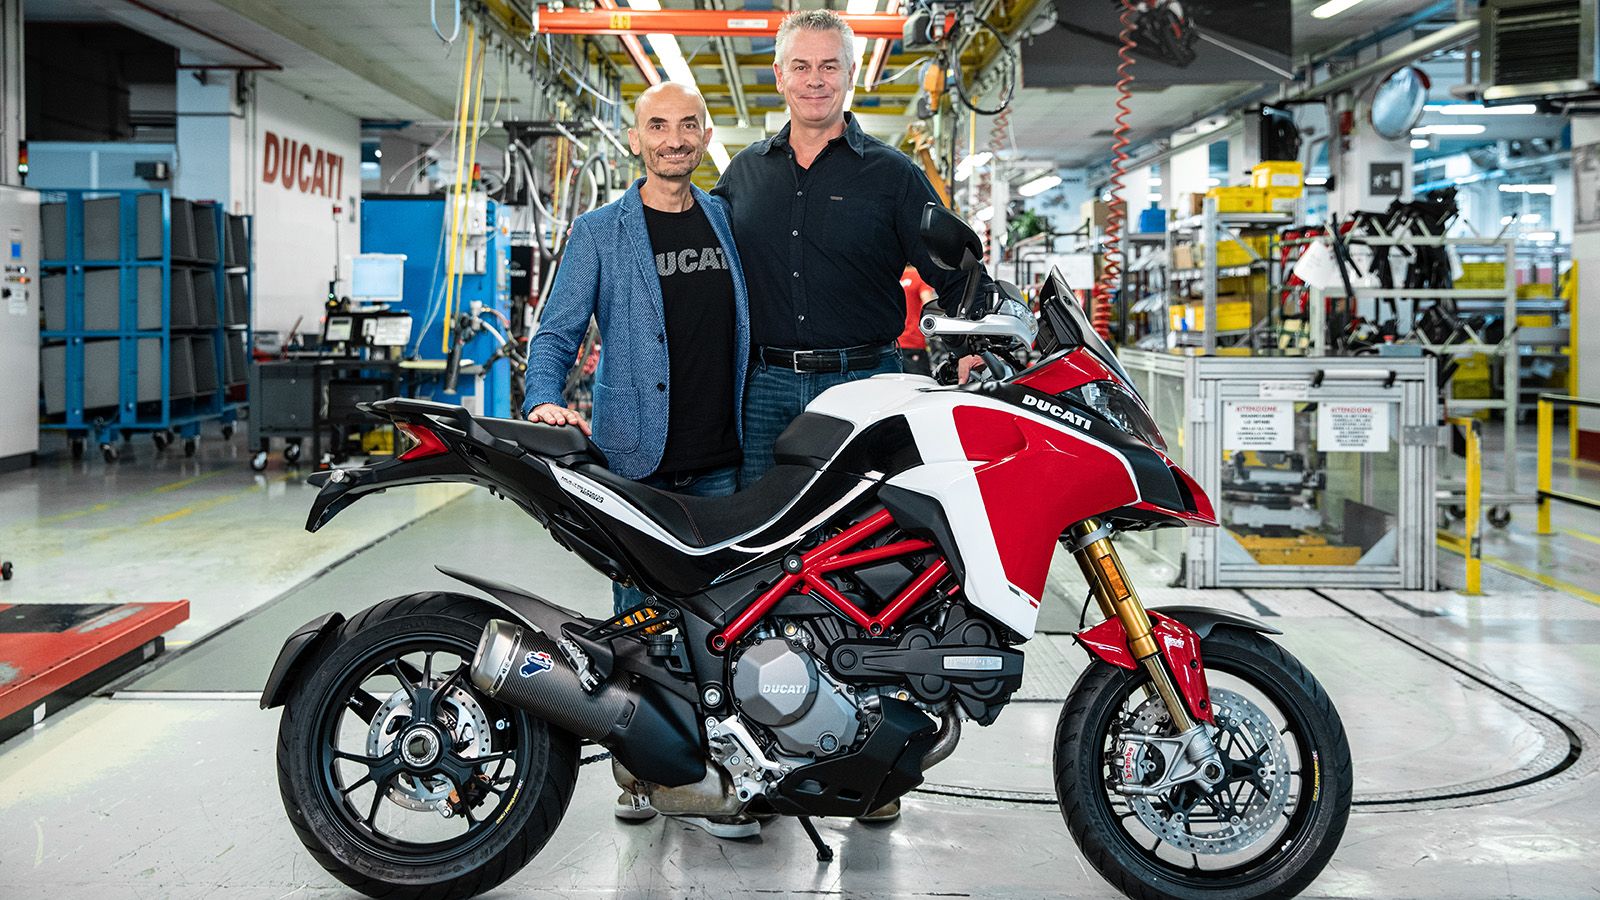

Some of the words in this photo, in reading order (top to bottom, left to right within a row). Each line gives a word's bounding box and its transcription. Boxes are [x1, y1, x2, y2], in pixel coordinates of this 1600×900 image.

[262, 130, 344, 201] DUCATI
[655, 246, 729, 277] UCAT
[1021, 393, 1092, 431] DUCATI
[762, 684, 807, 694] DUCATI
[1124, 747, 1134, 779] brembo
